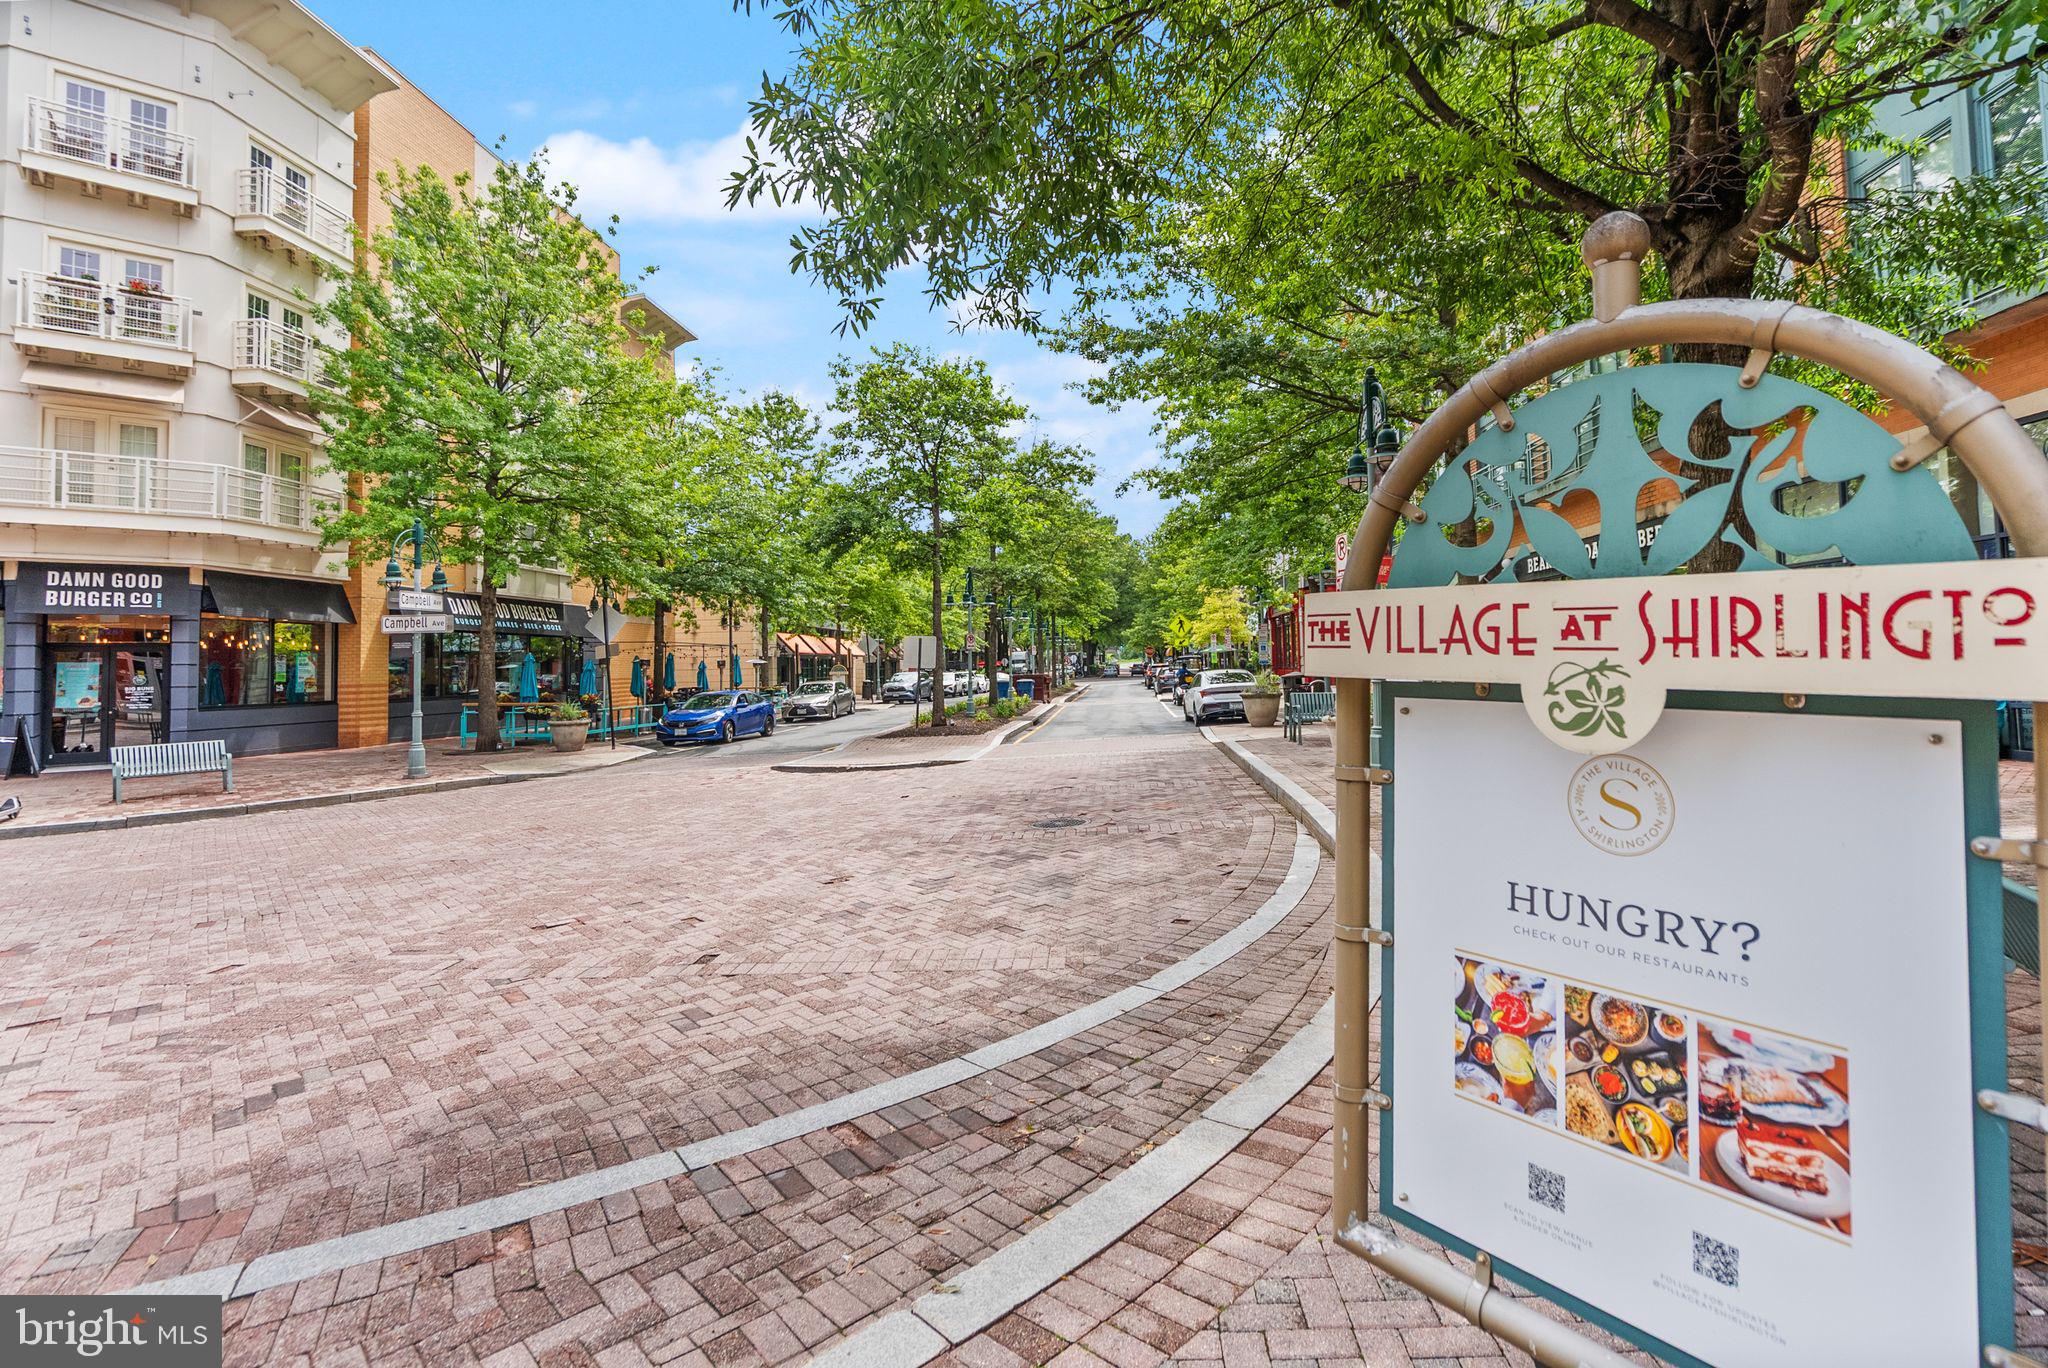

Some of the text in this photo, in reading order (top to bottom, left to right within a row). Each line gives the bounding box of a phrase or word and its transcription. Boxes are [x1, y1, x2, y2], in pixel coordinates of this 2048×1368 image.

[47, 571, 163, 589] DAMN GOOD
[45, 590, 126, 608] BURGER
[130, 592, 153, 608] CO
[401, 593, 431, 607] Campbell
[447, 597, 482, 616] DAMN
[509, 603, 548, 622] BURGER
[546, 607, 559, 622] CO
[384, 616, 428, 631] Campbell
[1307, 620, 1351, 643] THE
[1356, 602, 1538, 656] VILLAGE
[1560, 614, 1613, 641] AT
[1582, 760, 1657, 789] THE VILLAGE
[1599, 778, 1642, 831] S
[1576, 808, 1665, 849] AT SHIRLINGTON
[1507, 880, 1760, 962] HUNGRY?
[1513, 925, 1750, 988] CHECK OUT OUR RESTAURANTS
[1540, 1217, 1561, 1233] VIEW
